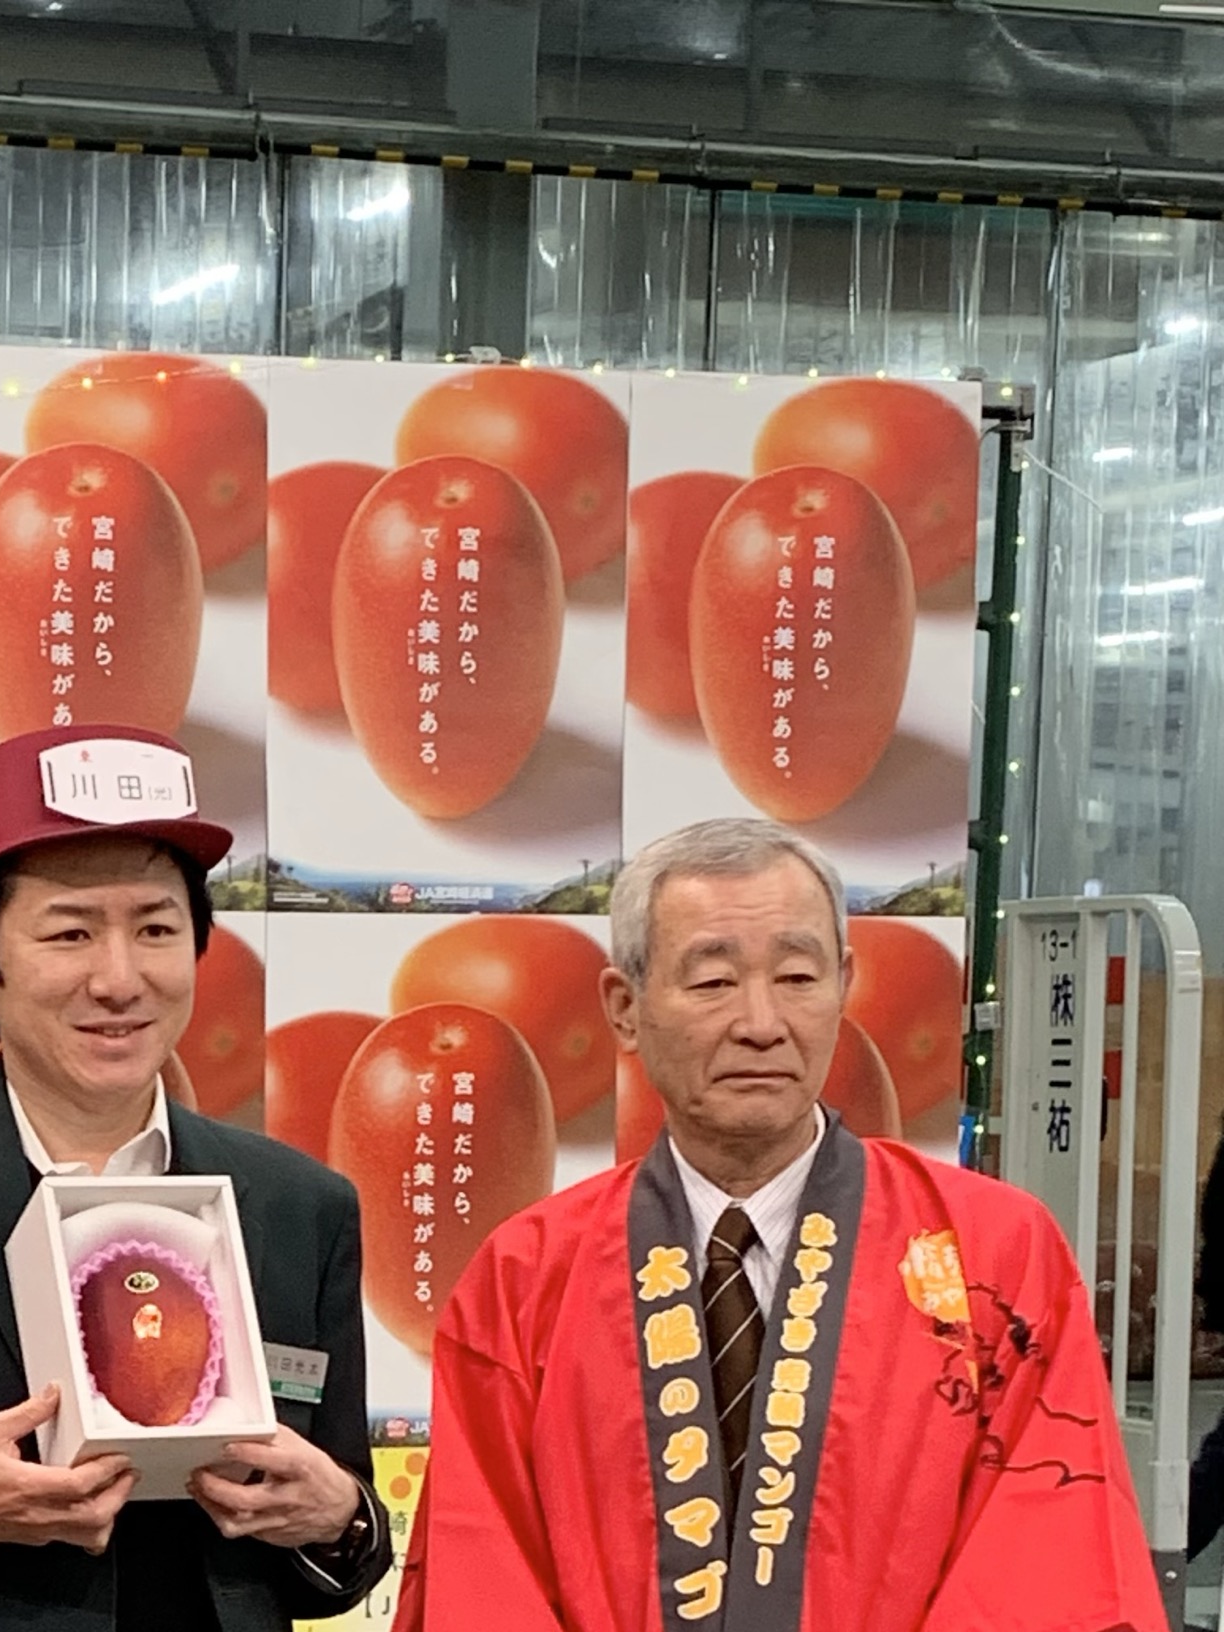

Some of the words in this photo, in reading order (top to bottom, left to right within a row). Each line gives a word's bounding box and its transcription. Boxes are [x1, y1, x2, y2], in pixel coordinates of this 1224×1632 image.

[92, 515, 115, 677] 宮崎だから、
[418, 526, 441, 774] できた美味がある。
[458, 526, 480, 685] 宮崎だから、
[772, 534, 796, 778] できた美味がある。
[812, 534, 835, 690] 宮崎だから、
[413, 1071, 436, 1312] できた美味がある。
[452, 1071, 475, 1225] 宮崎だから、
[637, 1246, 727, 1620] 太陽のタマゴ
